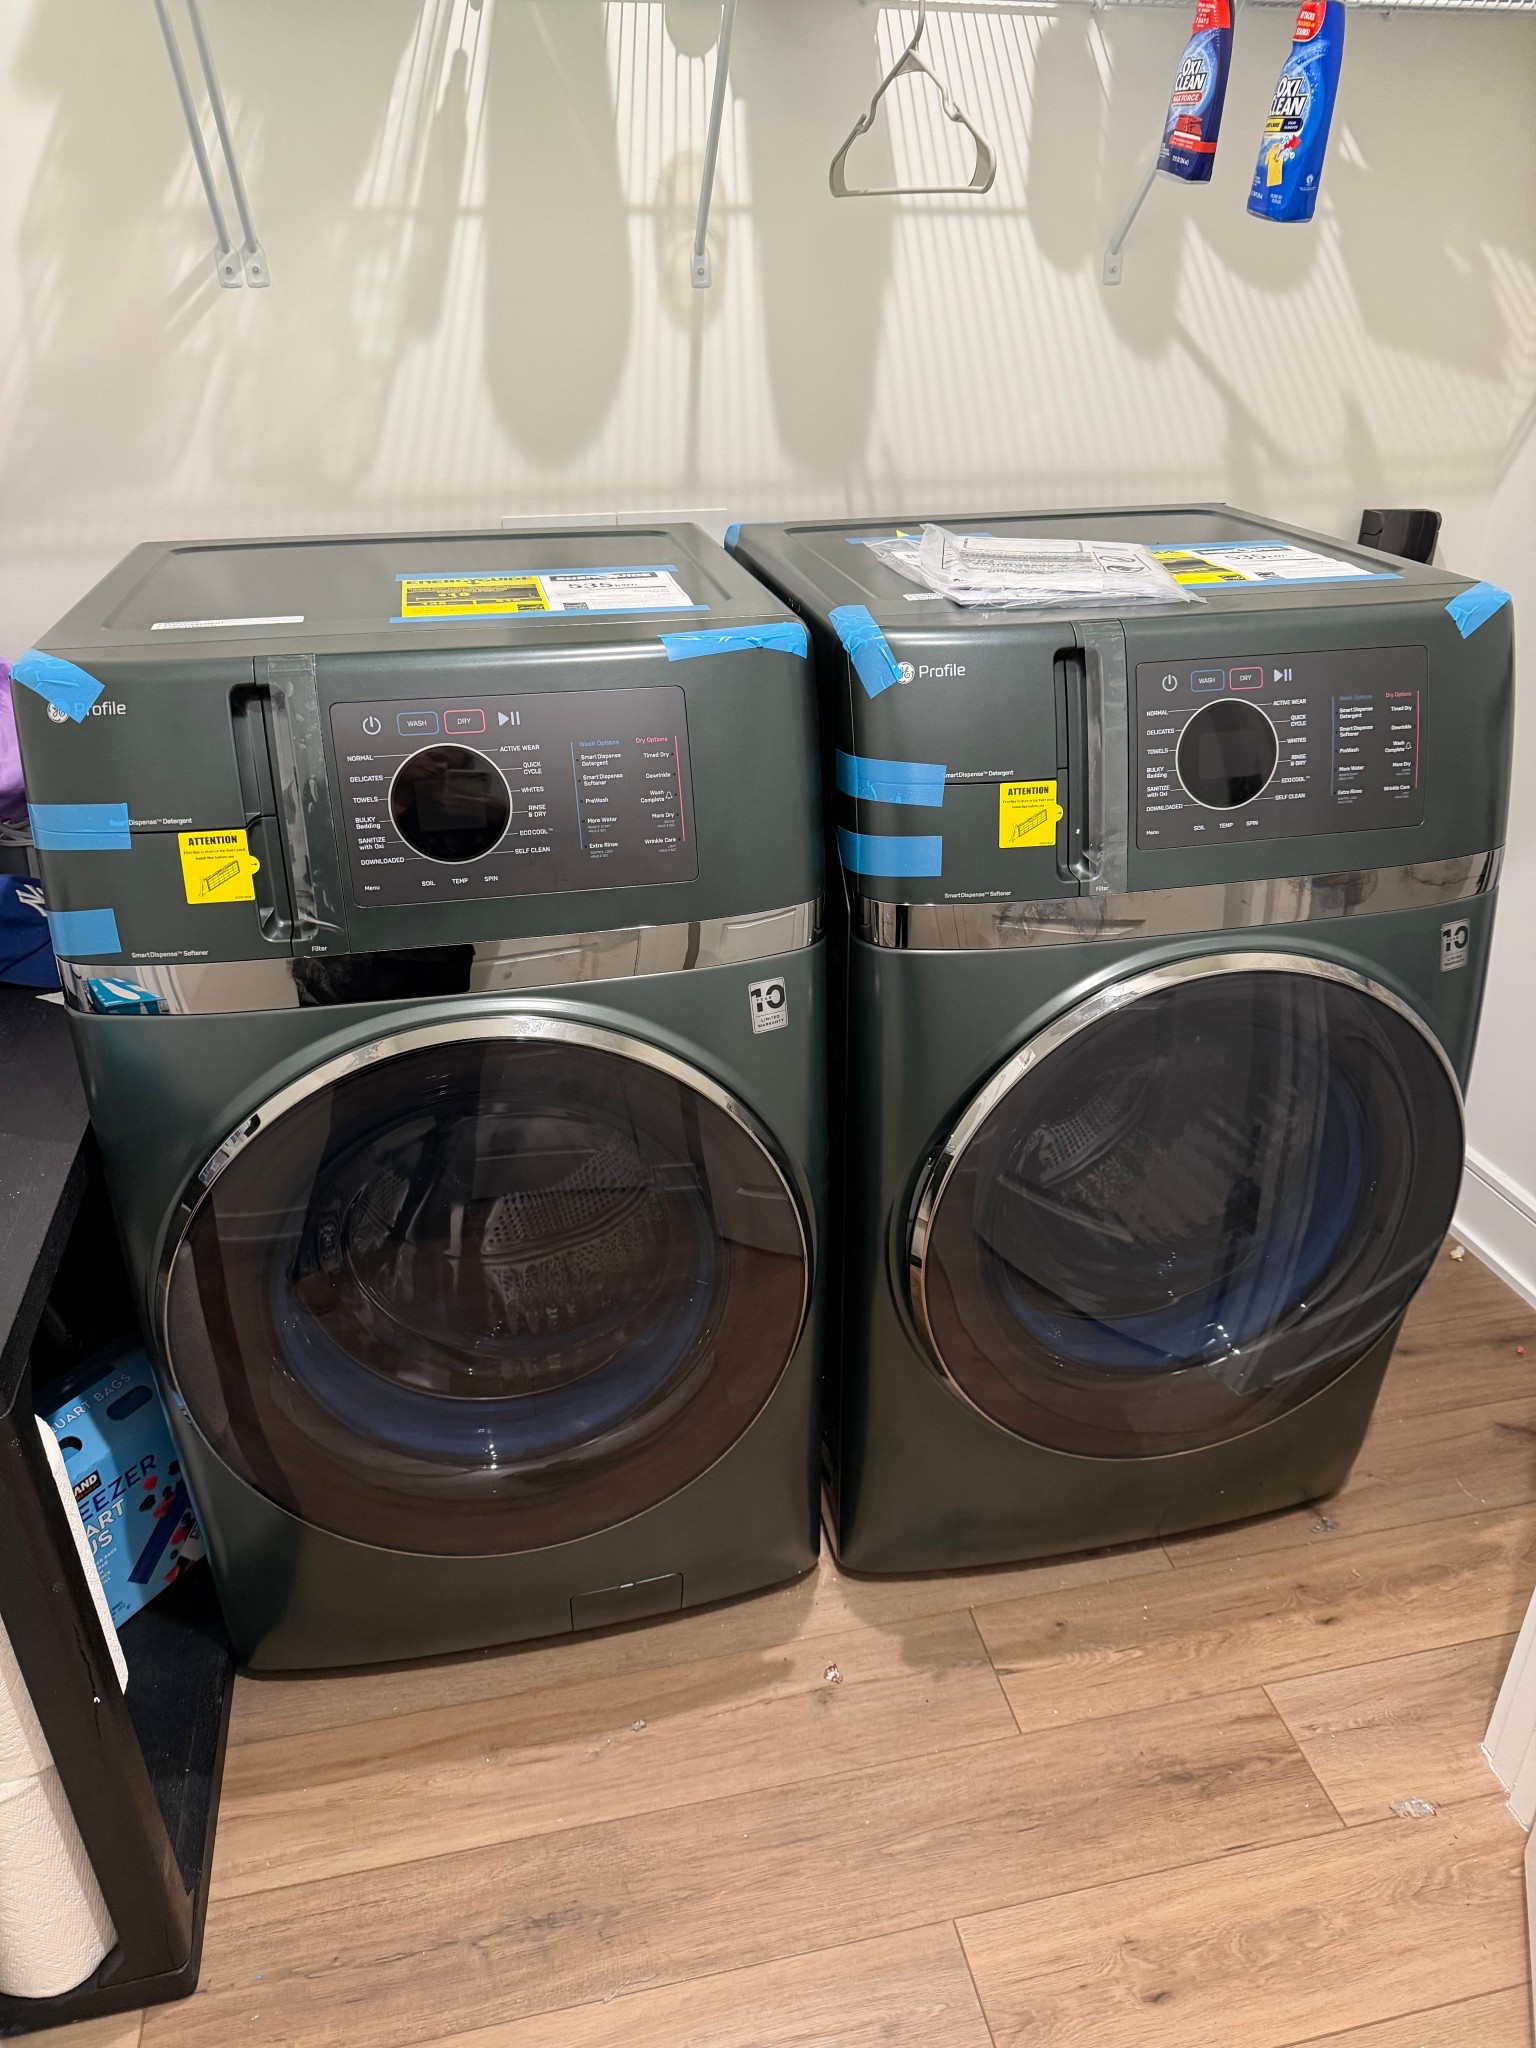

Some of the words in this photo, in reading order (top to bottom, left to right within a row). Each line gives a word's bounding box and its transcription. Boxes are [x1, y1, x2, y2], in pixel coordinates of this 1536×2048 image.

[1182, 57, 1203, 76] OXI
[1175, 72, 1207, 92] CLEAN
[1276, 76, 1303, 97] OXI
[1182, 94, 1200, 102] FORCE
[1270, 94, 1307, 117] CLEAN
[919, 664, 966, 678] Profile
[406, 720, 428, 728] WASH
[457, 717, 472, 725] DRY
[350, 775, 384, 783] DELICATES
[1008, 786, 1049, 796] ATTENTION
[1146, 803, 1183, 812] DOWNLOADED
[162, 818, 193, 826] Detergent
[188, 835, 238, 846] ATTENTION
[360, 856, 404, 866] DOWNLOADED
[1443, 926, 1468, 952] 10
[750, 984, 786, 1012] 10
[758, 1018, 785, 1028] WARRANTY
[760, 1014, 780, 1022] LIMITED
[50, 1400, 91, 1433] UART
[93, 1374, 131, 1402] BAGS
